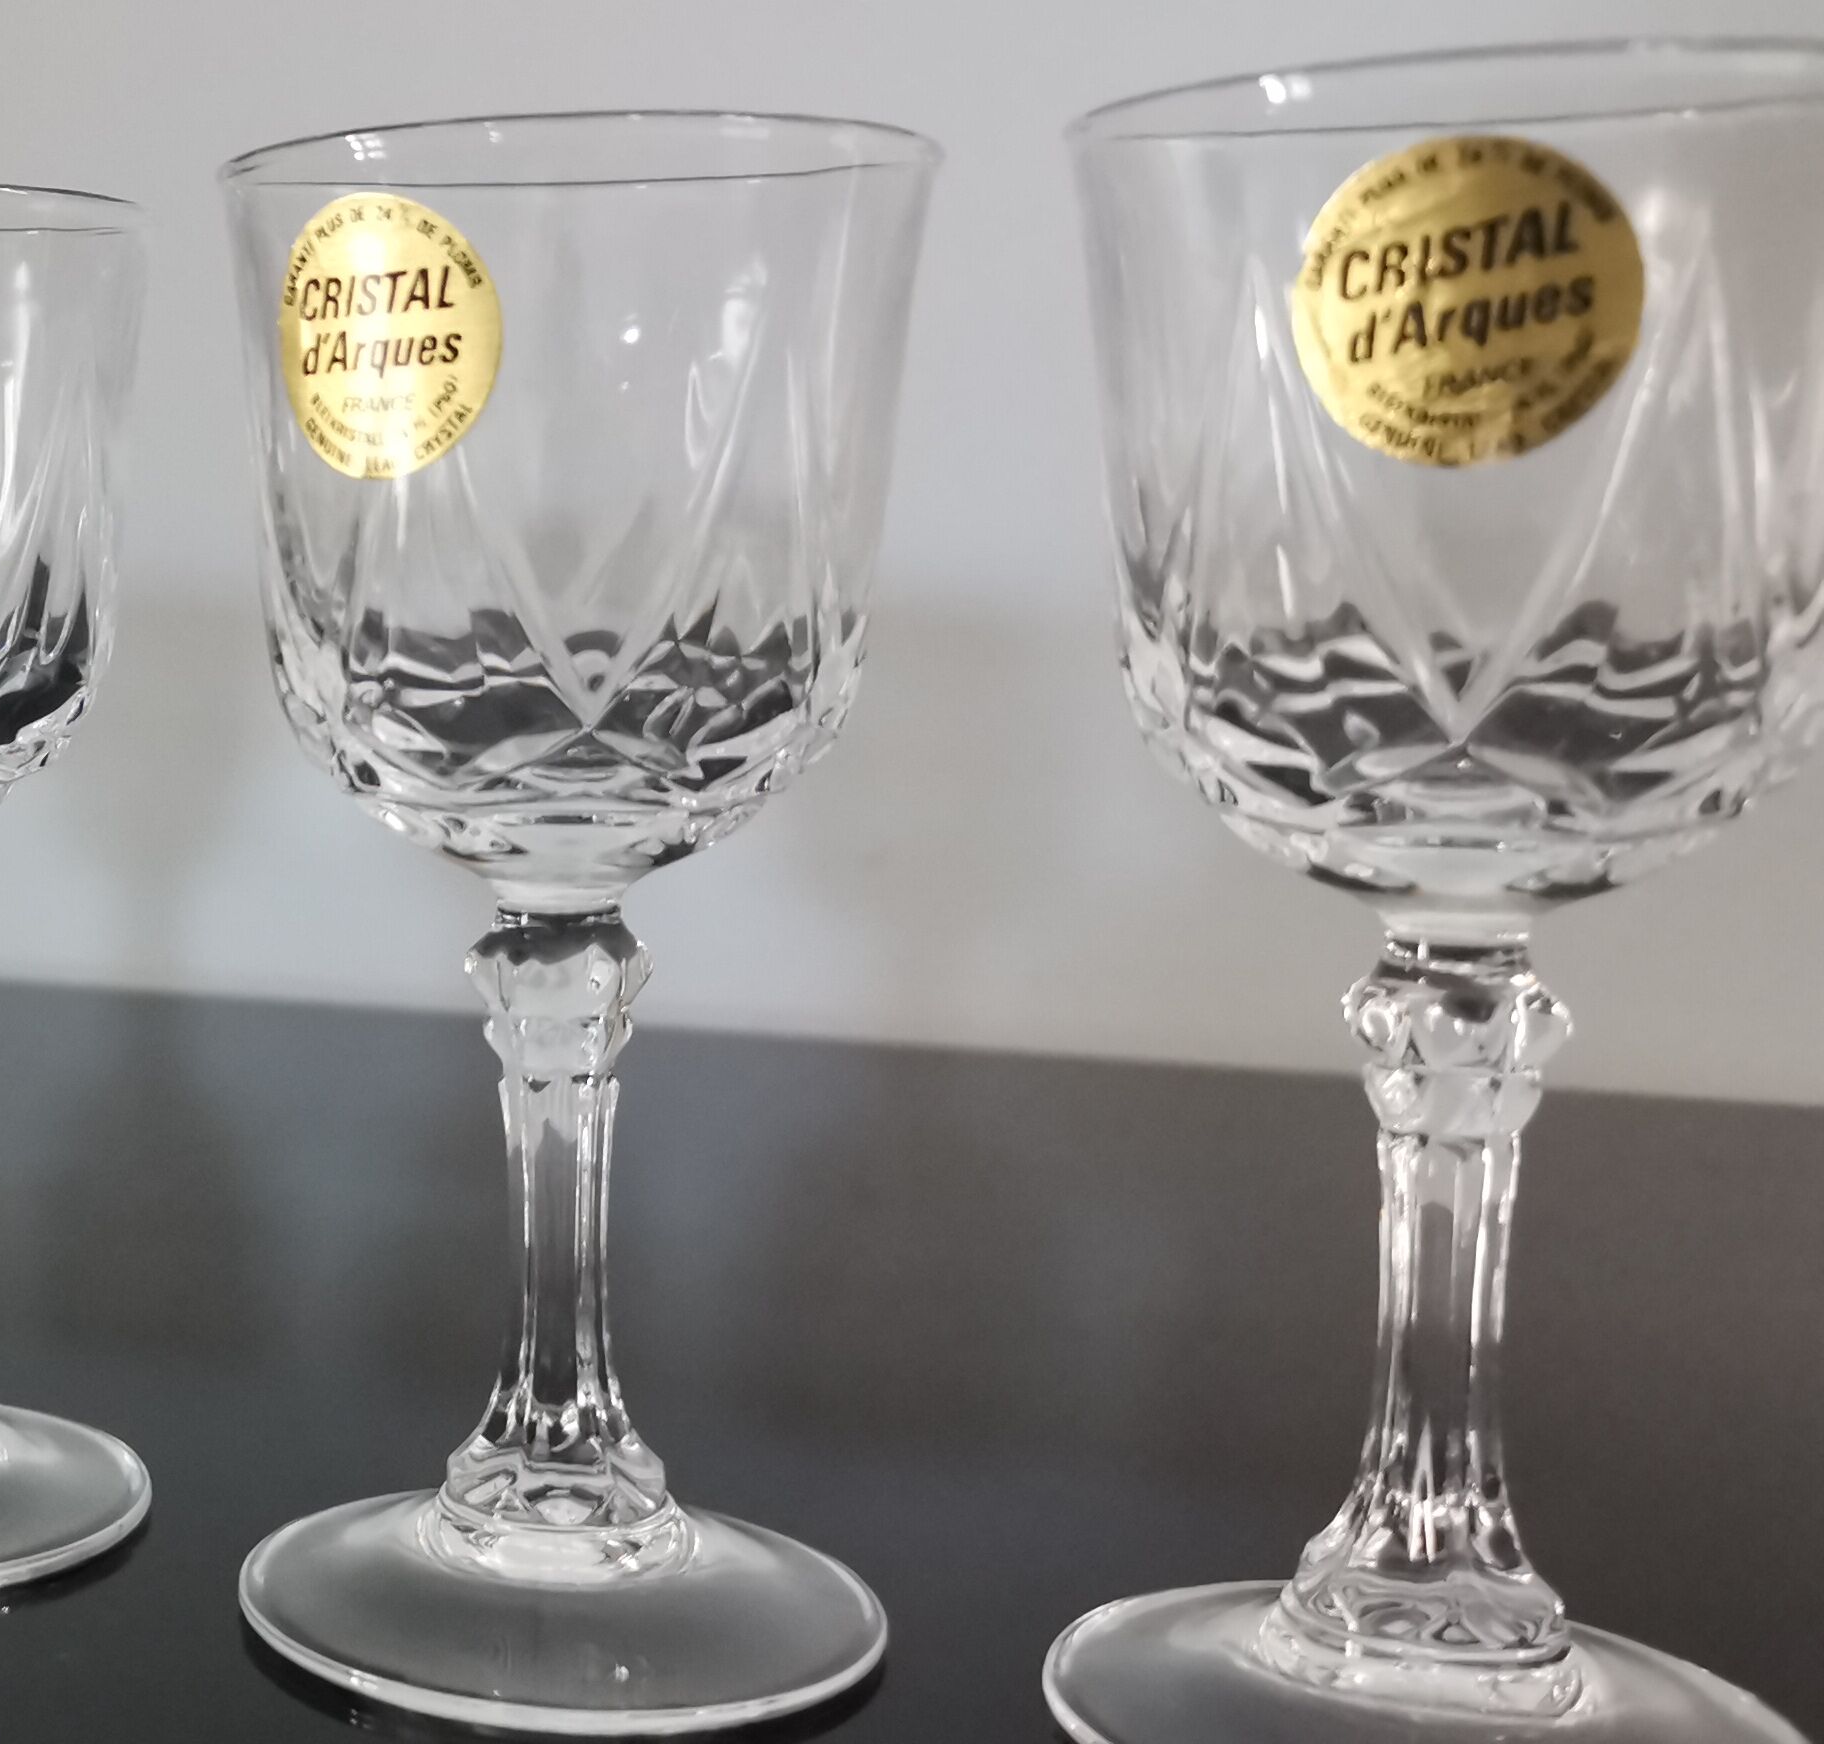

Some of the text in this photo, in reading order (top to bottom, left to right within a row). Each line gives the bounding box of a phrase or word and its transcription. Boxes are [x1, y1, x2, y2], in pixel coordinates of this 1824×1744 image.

[1338, 201, 1580, 302] CRISTAL
[298, 265, 455, 322] CRISTAL
[1349, 275, 1596, 364] d'Arques
[302, 330, 463, 379] d'Arques
[341, 395, 415, 413] FRANCE
